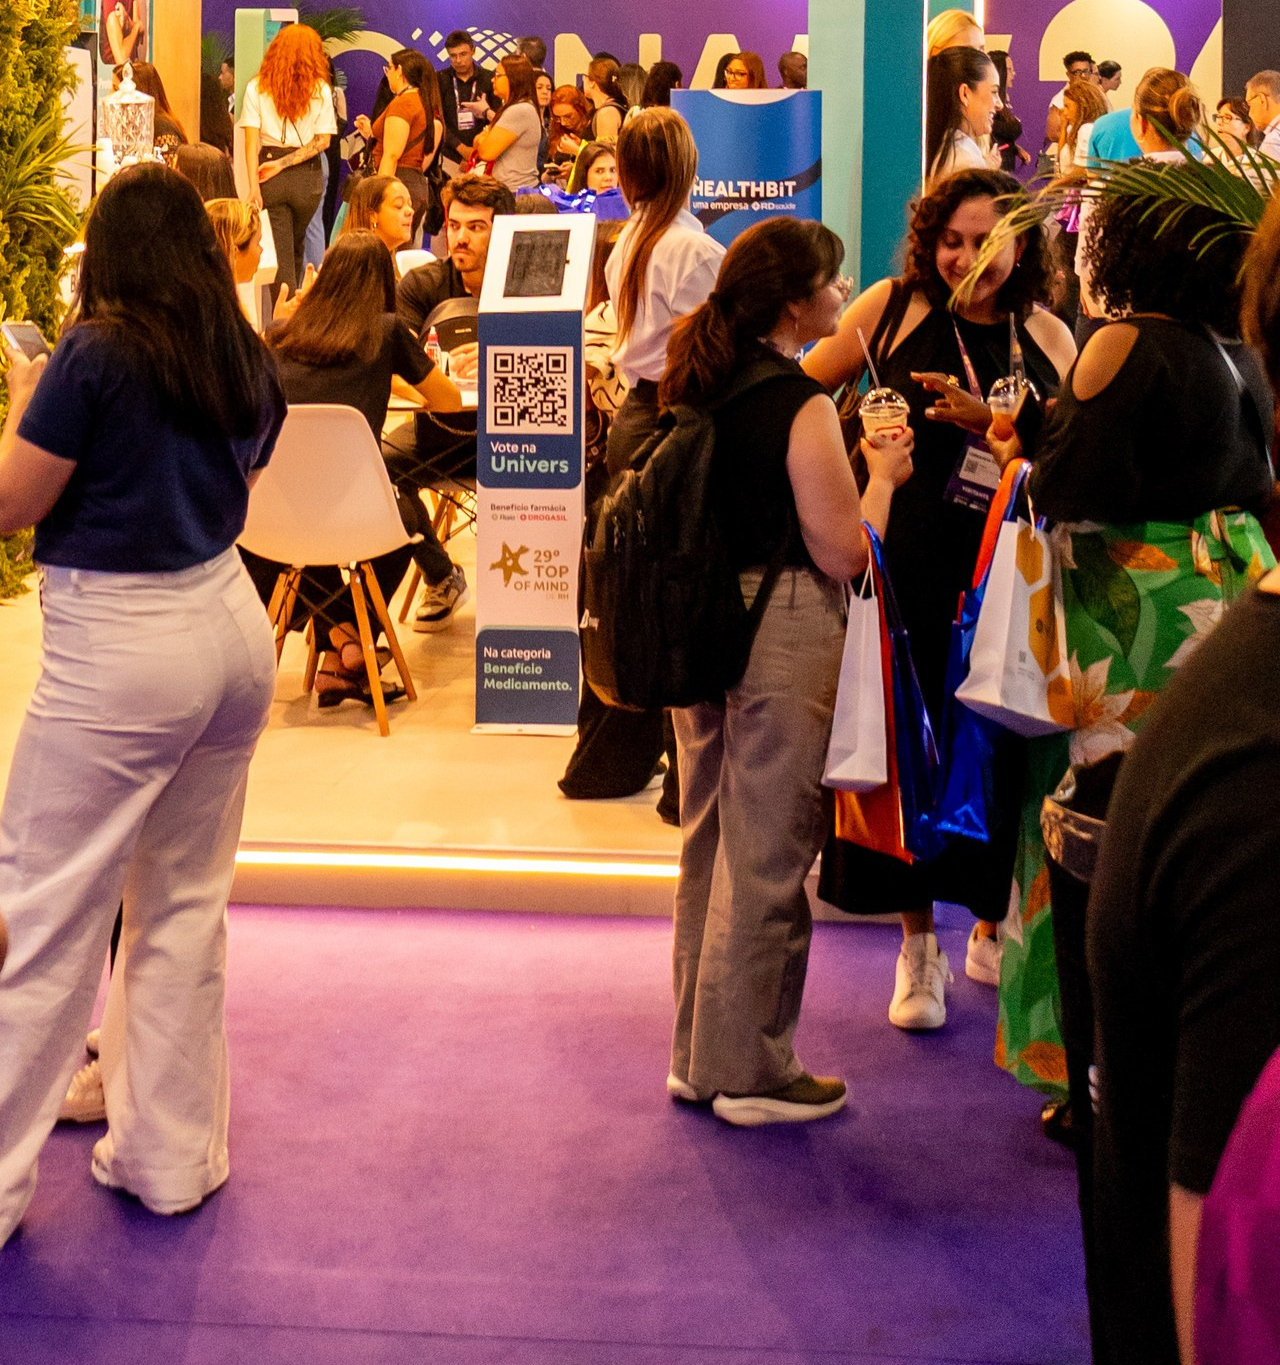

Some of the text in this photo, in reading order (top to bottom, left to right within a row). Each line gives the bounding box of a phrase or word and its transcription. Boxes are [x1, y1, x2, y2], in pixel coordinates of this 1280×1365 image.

[692, 201, 710, 210] uma
[710, 201, 749, 212] empresa
[490, 441, 537, 454] Vote na
[490, 454, 569, 474] Univers
[533, 565, 569, 579] TOP
[513, 580, 569, 592] OF MIND
[483, 646, 552, 662] Na categoria
